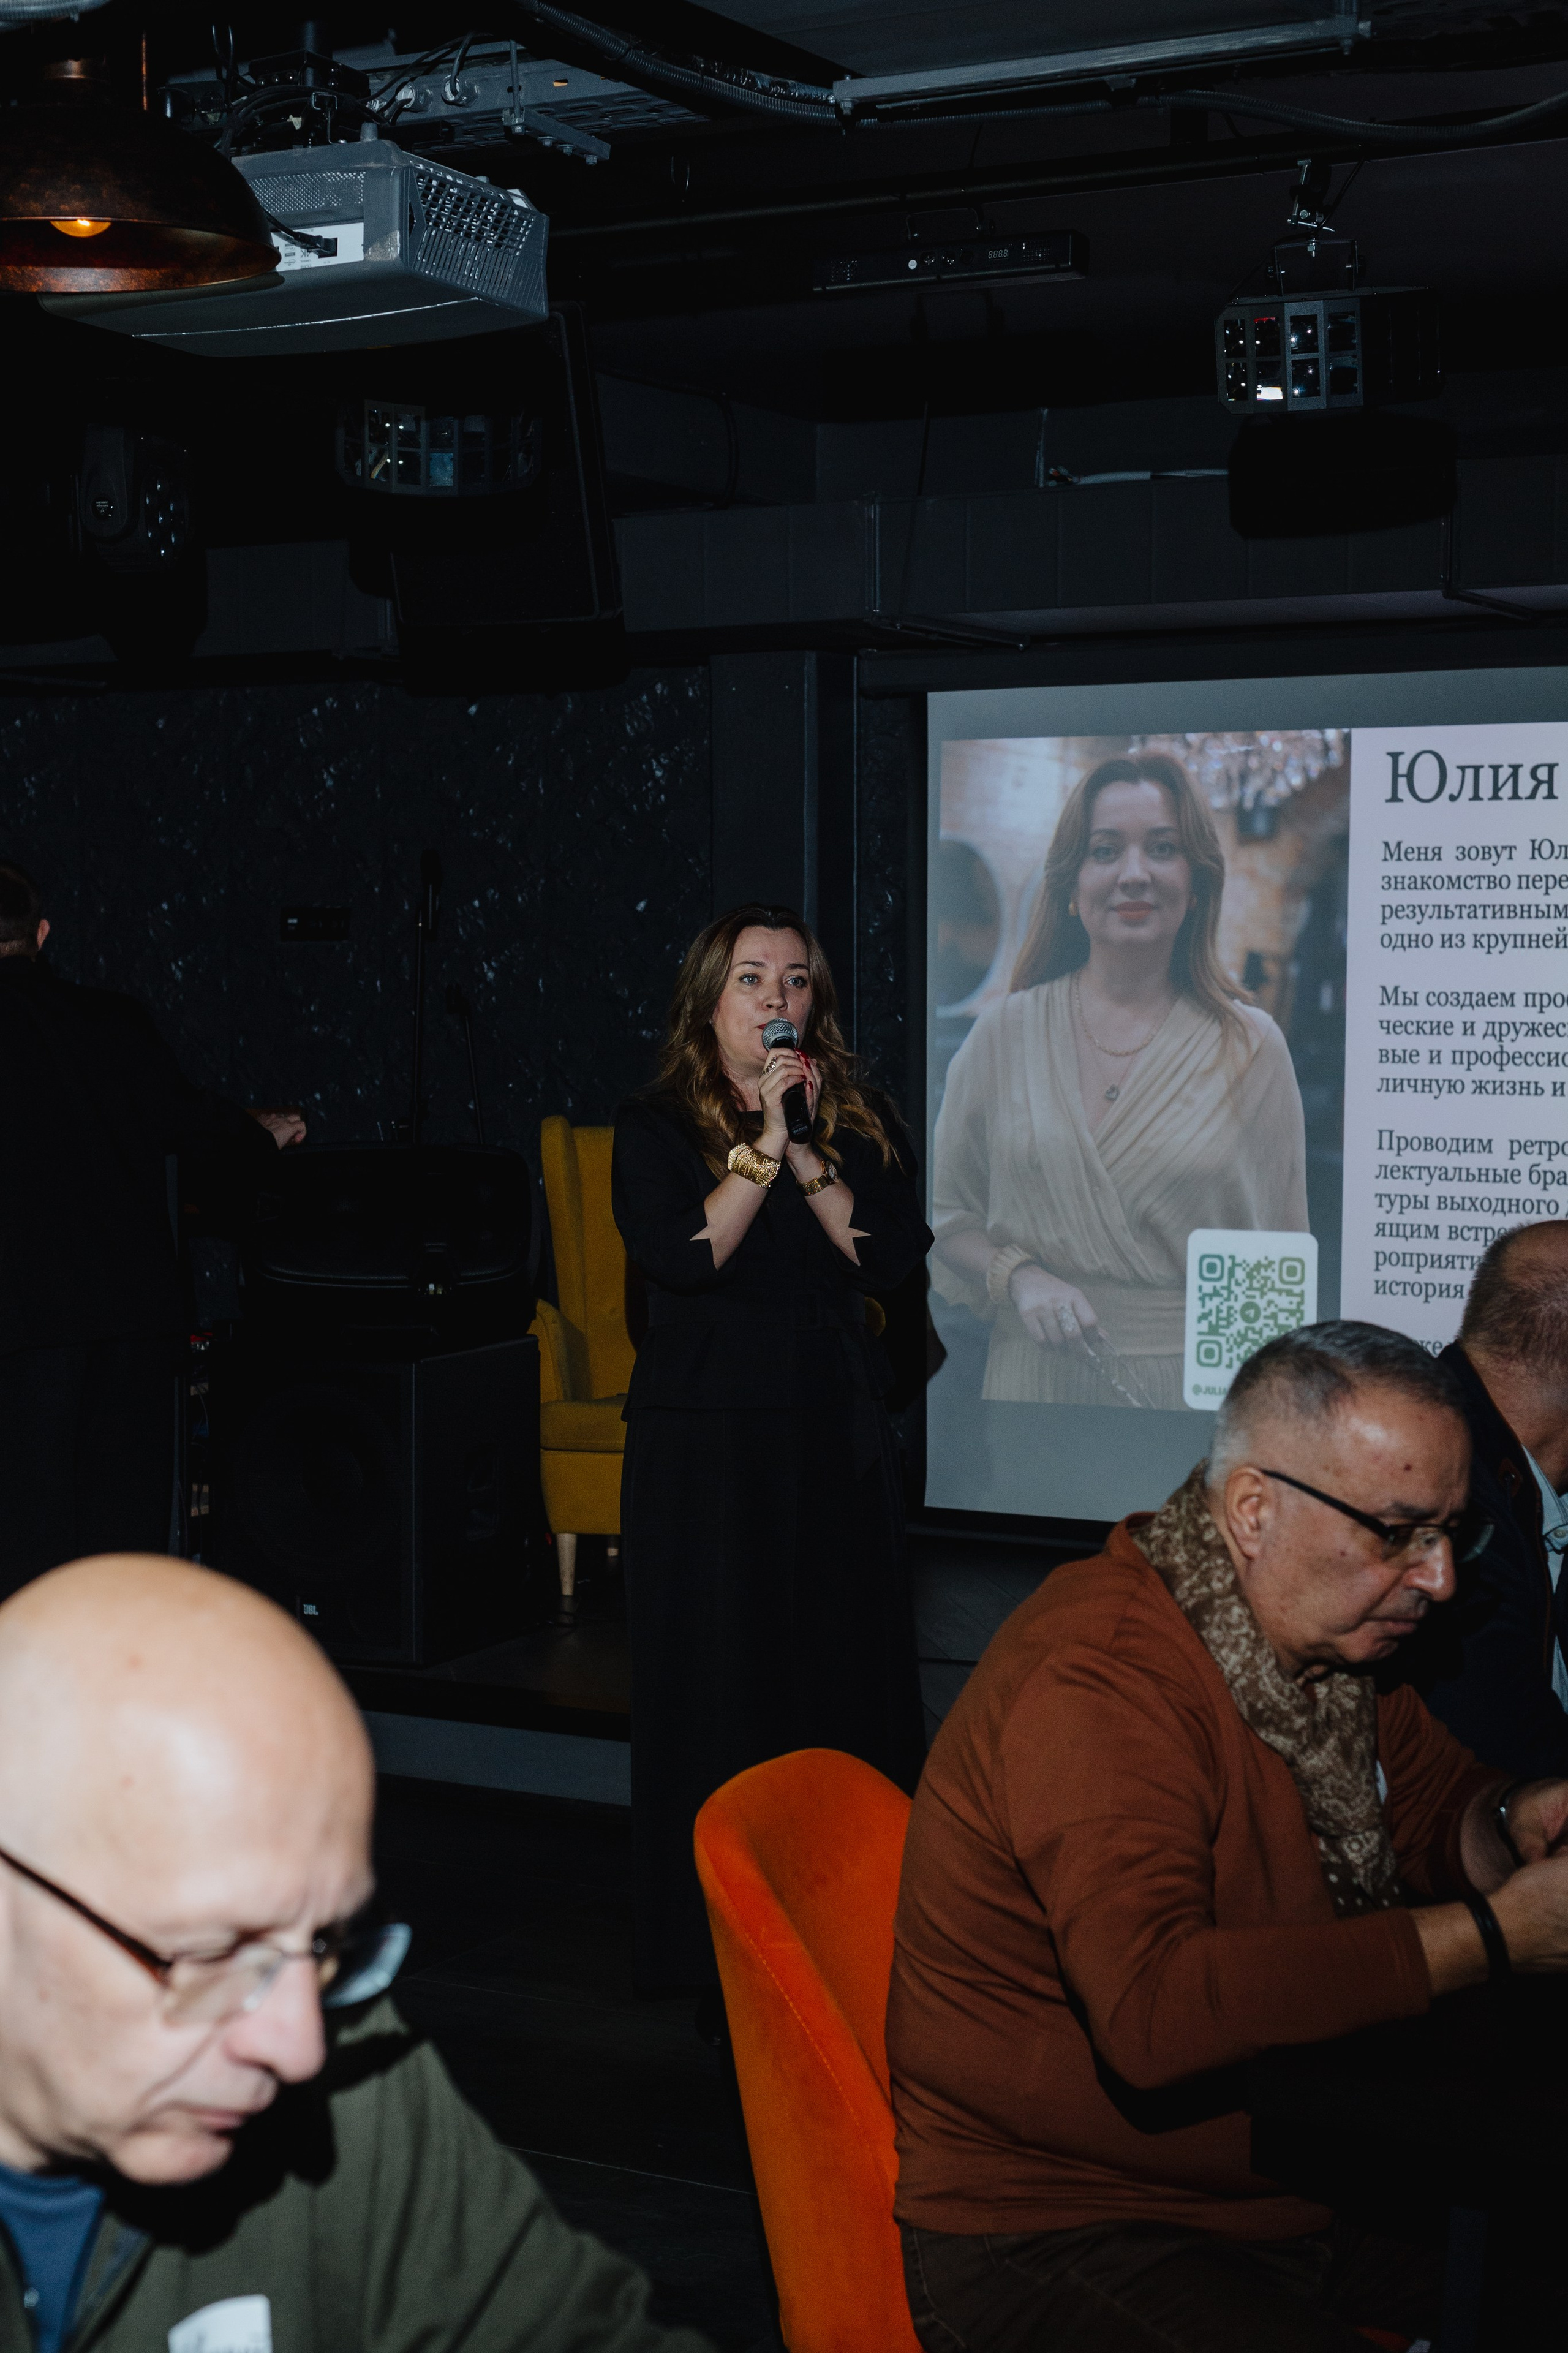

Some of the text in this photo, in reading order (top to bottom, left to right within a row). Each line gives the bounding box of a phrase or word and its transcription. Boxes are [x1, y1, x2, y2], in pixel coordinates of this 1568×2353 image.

[1385, 749, 1559, 803] Юлия
[1382, 838, 1568, 866] Меня зовут Юл
[1381, 874, 1568, 896] знакомство пере
[1380, 904, 1568, 925] результативным
[1380, 926, 1568, 954] одно из крупней
[1379, 985, 1568, 1014] Мы создаем про
[1378, 1019, 1568, 1043] ческие и дружес
[1378, 1048, 1420, 1065] вые
[1428, 1049, 1442, 1065] и
[1376, 1077, 1566, 1100] личную жизнь и
[1376, 1128, 1493, 1157] Проводим
[1375, 1162, 1568, 1191] лектуальные бра
[1374, 1193, 1430, 1214] туры
[1436, 1195, 1559, 1216] выходного
[1374, 1222, 1441, 1241] ящим
[1374, 1279, 1465, 1303] история
[303, 1604, 318, 1615] JBL
